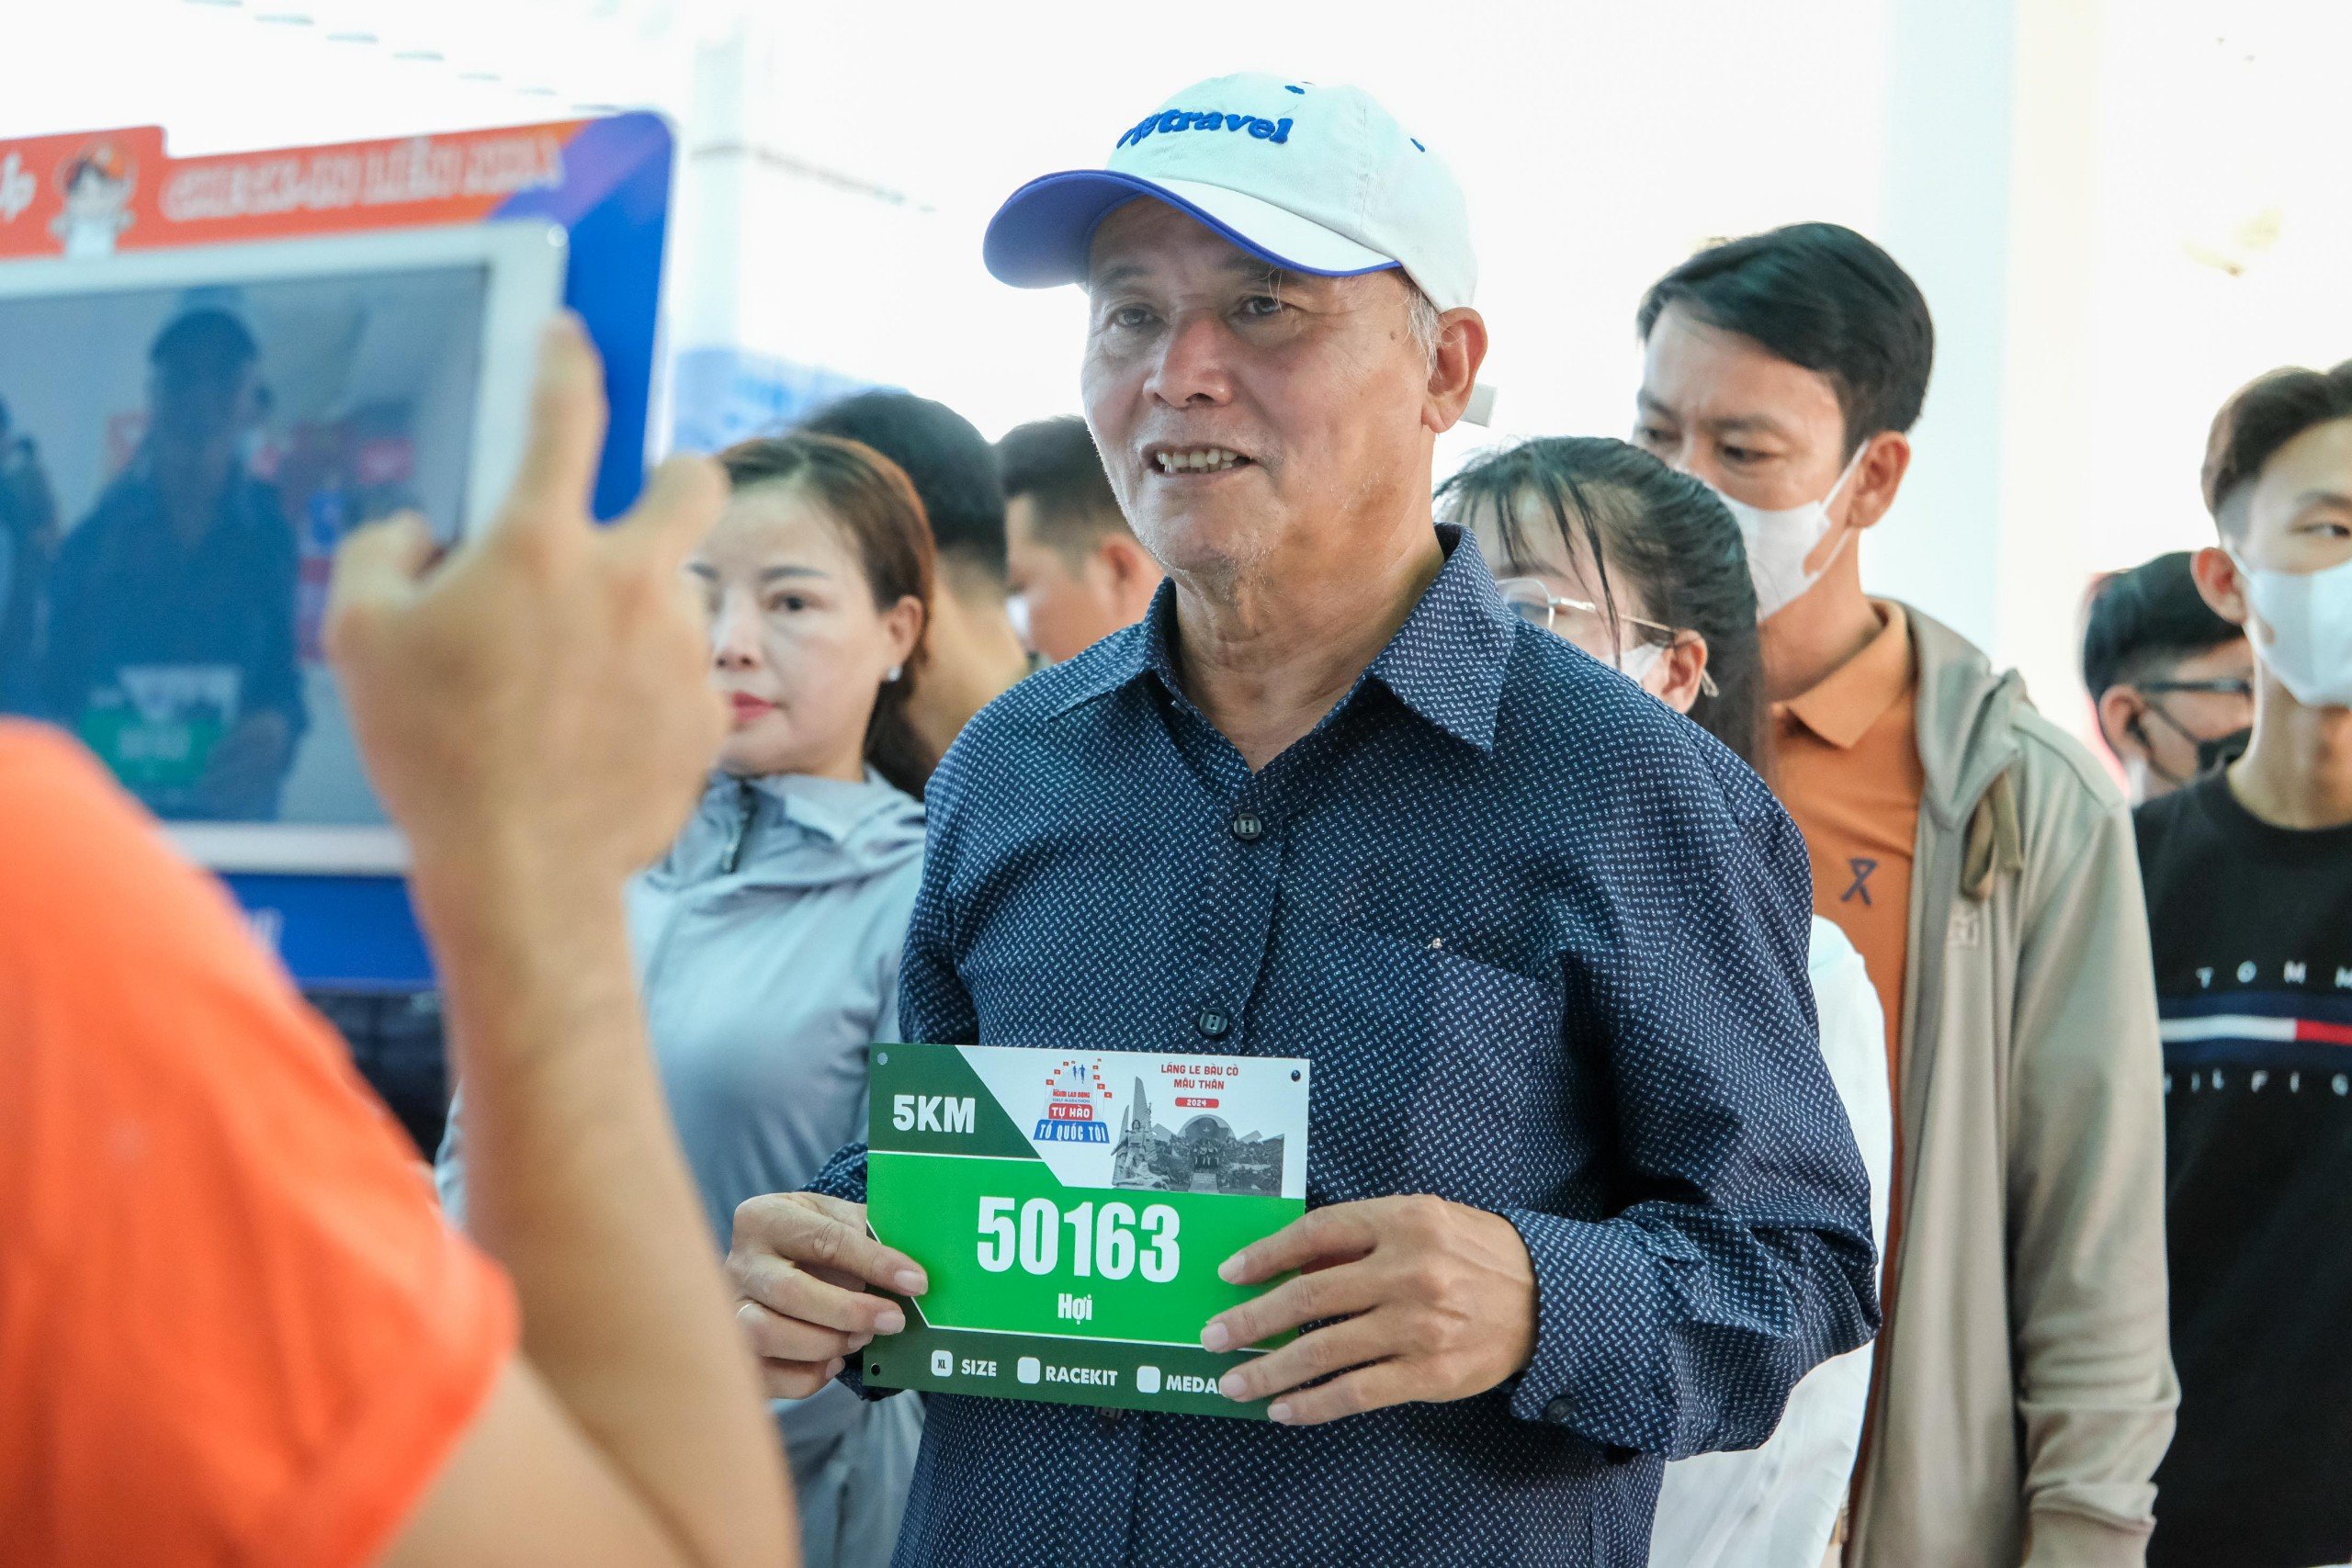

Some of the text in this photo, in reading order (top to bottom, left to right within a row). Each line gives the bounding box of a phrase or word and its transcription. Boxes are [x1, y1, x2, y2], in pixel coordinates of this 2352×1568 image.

[1189, 1066, 1201, 1075] LE
[892, 1094, 976, 1134] 5KM
[1186, 1099, 1206, 1107] 2024
[977, 1196, 1181, 1283] 50163
[1057, 1293, 1093, 1325] Hợi
[937, 1359, 1221, 1395] XL SIZE RACEKIT MEDA
